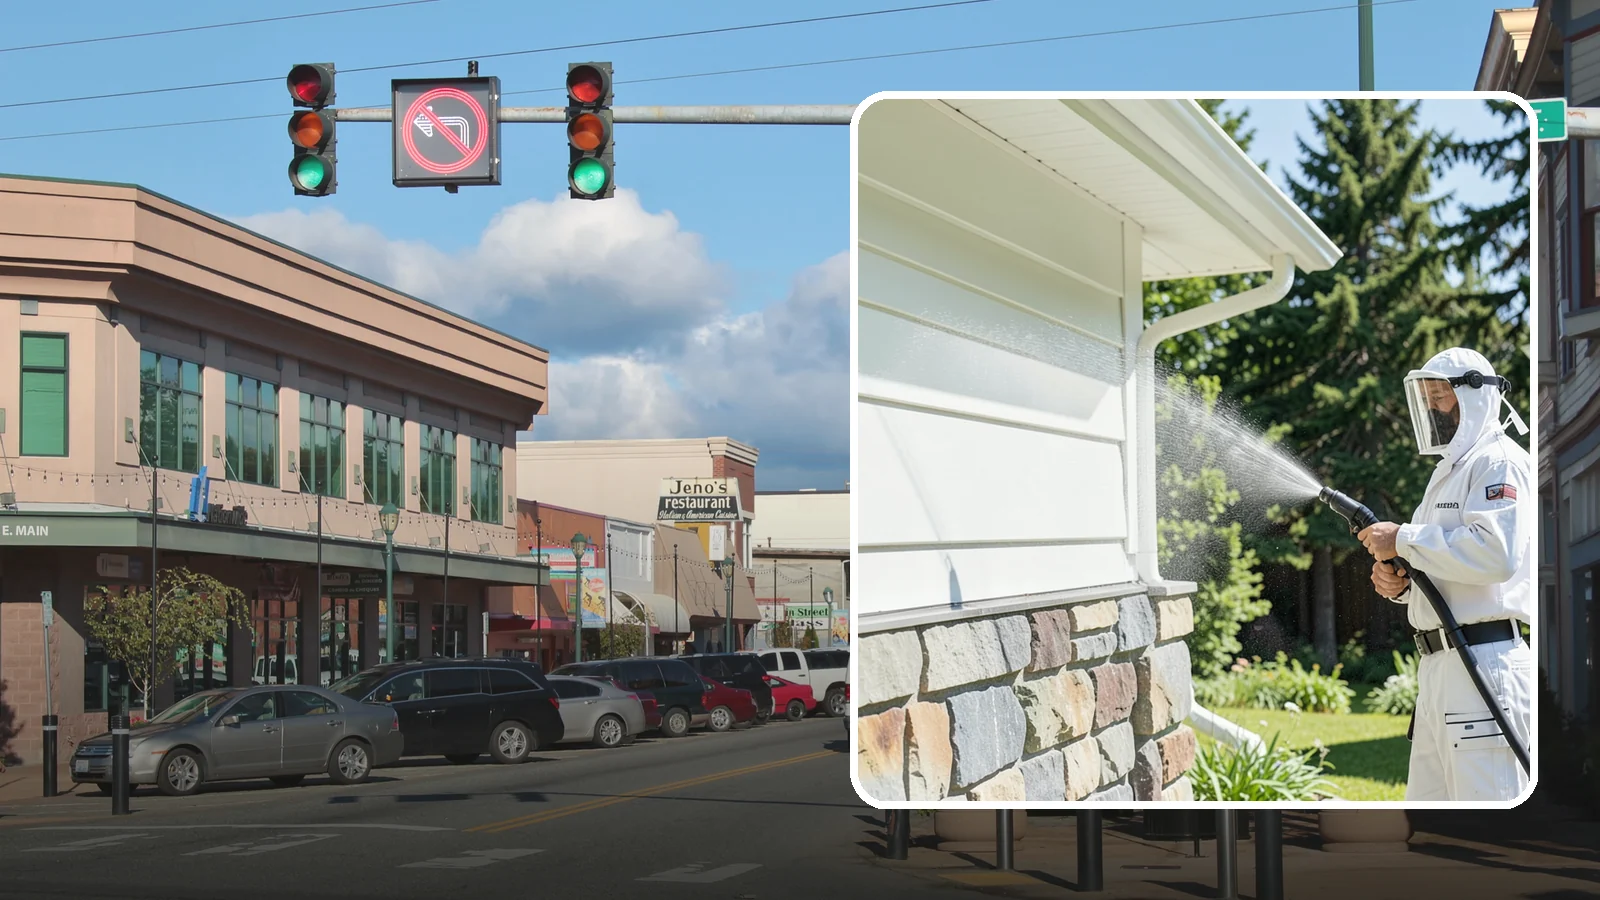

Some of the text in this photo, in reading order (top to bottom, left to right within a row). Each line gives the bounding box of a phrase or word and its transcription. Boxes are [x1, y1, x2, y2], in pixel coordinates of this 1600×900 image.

[669, 479, 728, 495] Jeno's
[665, 496, 731, 509] restaurant
[658, 509, 682, 520] Italian
[685, 509, 715, 520] American
[714, 509, 738, 520] Cuisine
[2, 525, 49, 536] E. MAIN
[797, 607, 829, 617] Street
